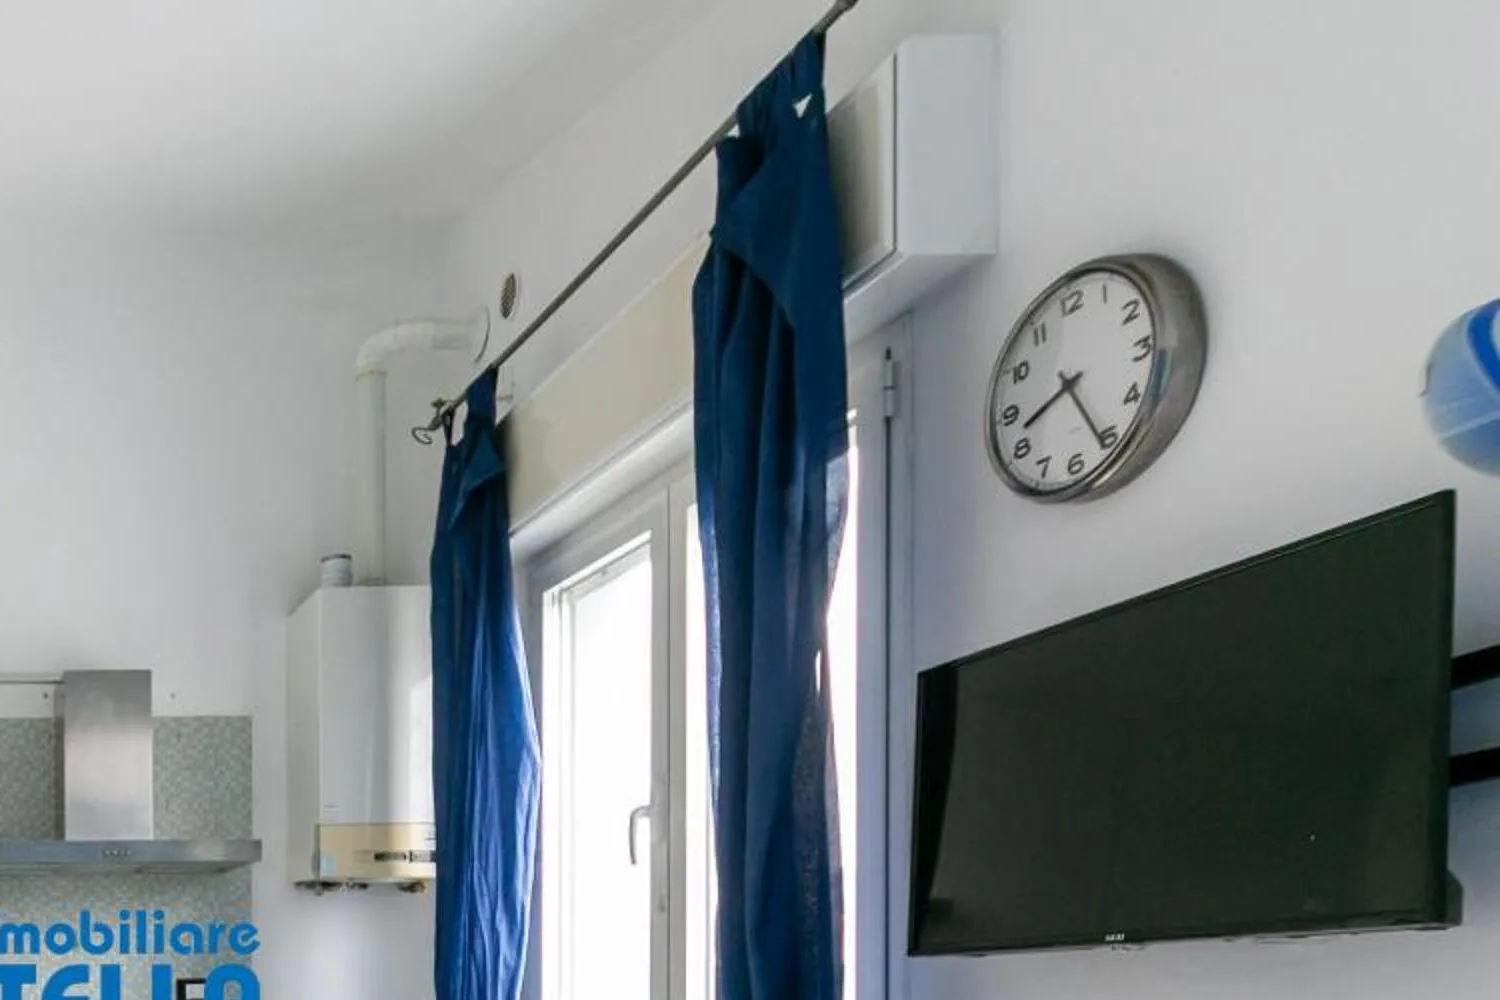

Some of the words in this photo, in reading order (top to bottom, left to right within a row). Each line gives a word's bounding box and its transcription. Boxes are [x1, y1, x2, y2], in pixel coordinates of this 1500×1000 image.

[1061, 291, 1084, 317] 12
[1102, 285, 1107, 303] 1
[1123, 301, 1140, 325] 2
[1034, 324, 1047, 347] 11
[1132, 336, 1153, 362] 3
[1014, 361, 1029, 384] 10
[1124, 383, 1140, 405] 4
[1003, 405, 1019, 426] 9
[1015, 438, 1031, 459] 8
[1101, 426, 1118, 449] 5
[1036, 456, 1051, 478] 7
[1068, 454, 1085, 475] 6
